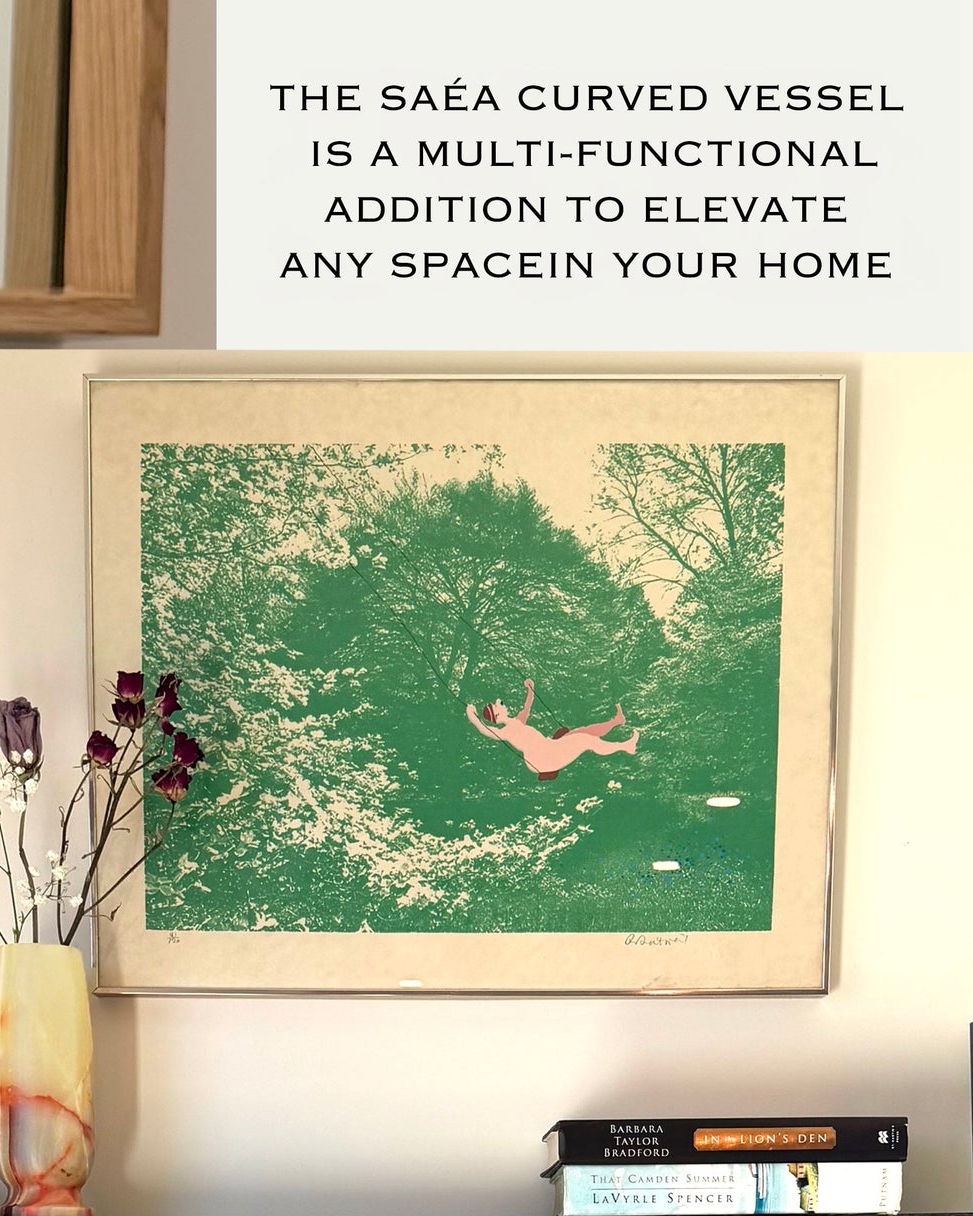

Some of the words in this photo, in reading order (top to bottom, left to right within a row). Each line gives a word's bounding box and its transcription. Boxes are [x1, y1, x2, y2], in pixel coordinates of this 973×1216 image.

[609, 1124, 664, 1134] BARBARA
[613, 1136, 659, 1146] TAYLOR
[704, 1135, 720, 1145] IN
[740, 1132, 789, 1145] LION'S
[798, 1133, 827, 1144] DEN
[604, 1147, 670, 1158] BRADFORD
